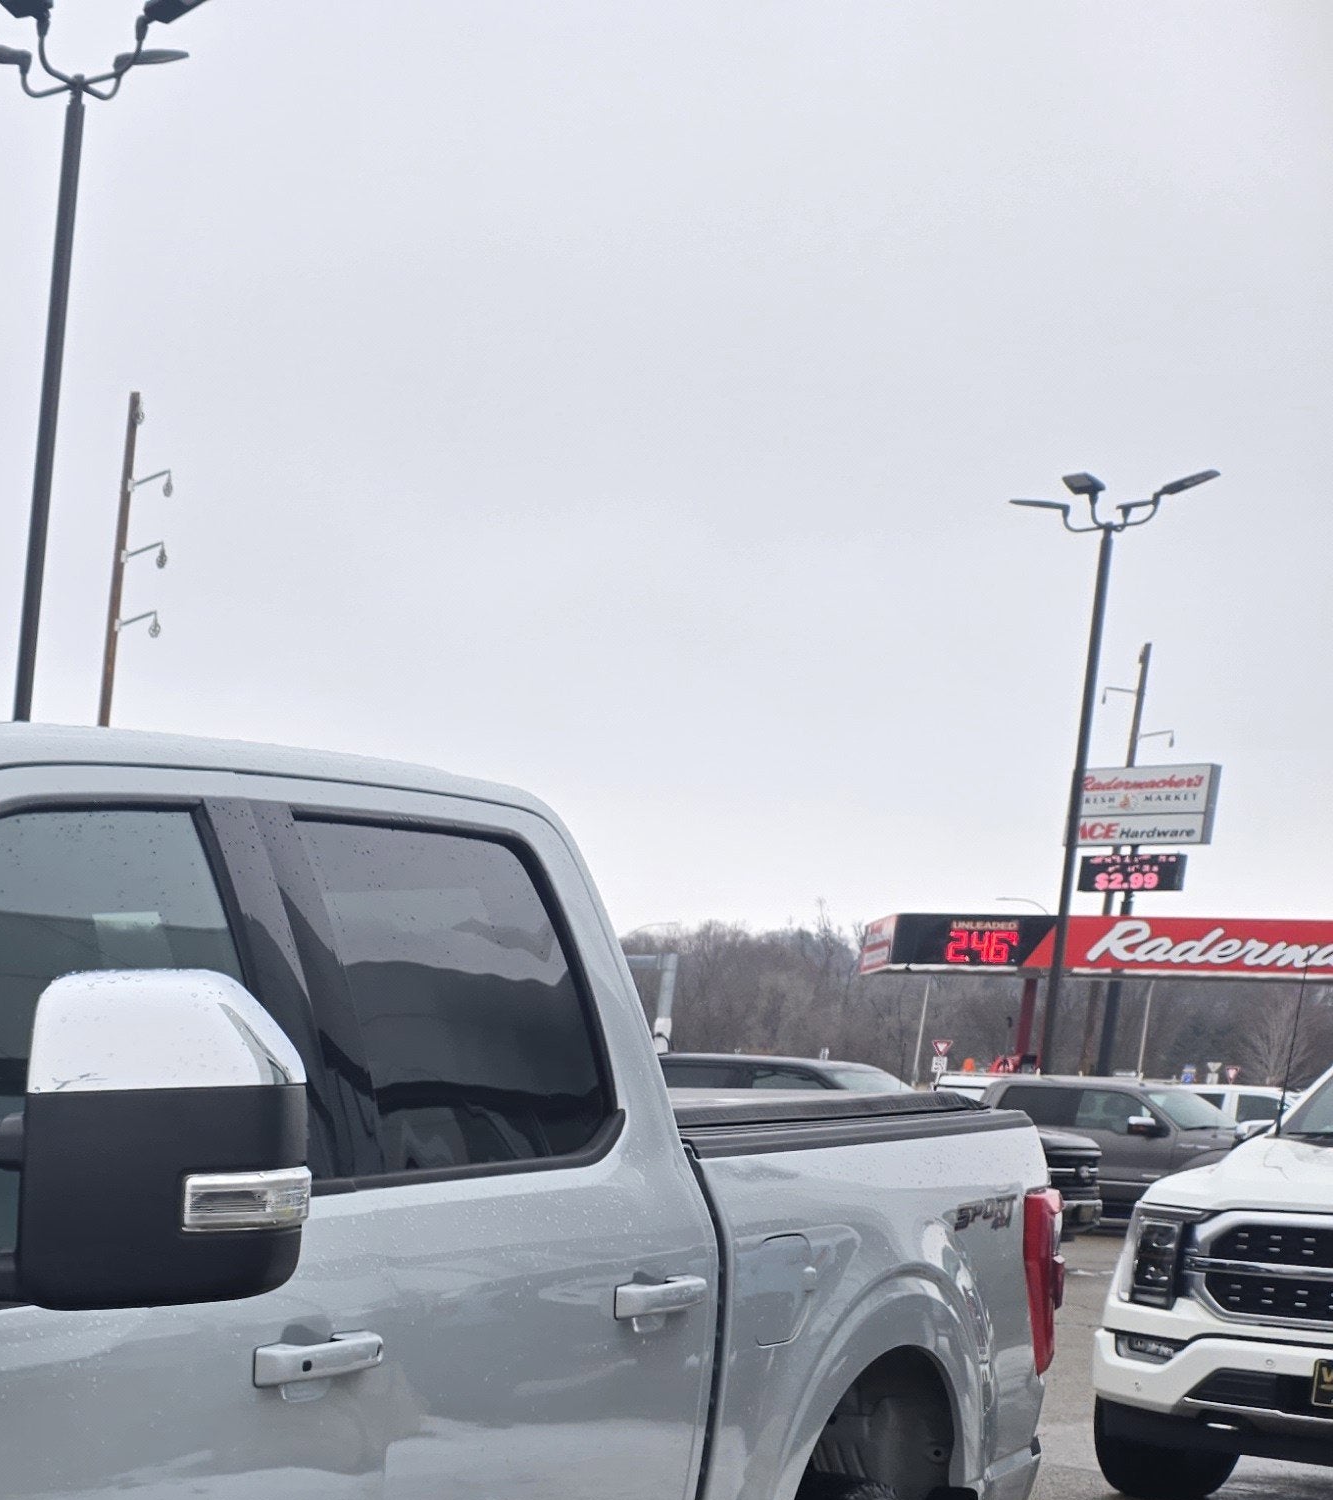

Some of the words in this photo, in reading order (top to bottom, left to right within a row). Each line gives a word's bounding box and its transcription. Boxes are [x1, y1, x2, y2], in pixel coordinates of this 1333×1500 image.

[1144, 792, 1197, 802] MARKET
[1119, 826, 1196, 839] Hardware
[1094, 872, 1159, 891] $2.99
[952, 921, 1019, 932] UNLEADED
[954, 1193, 1018, 1231] SPORT
